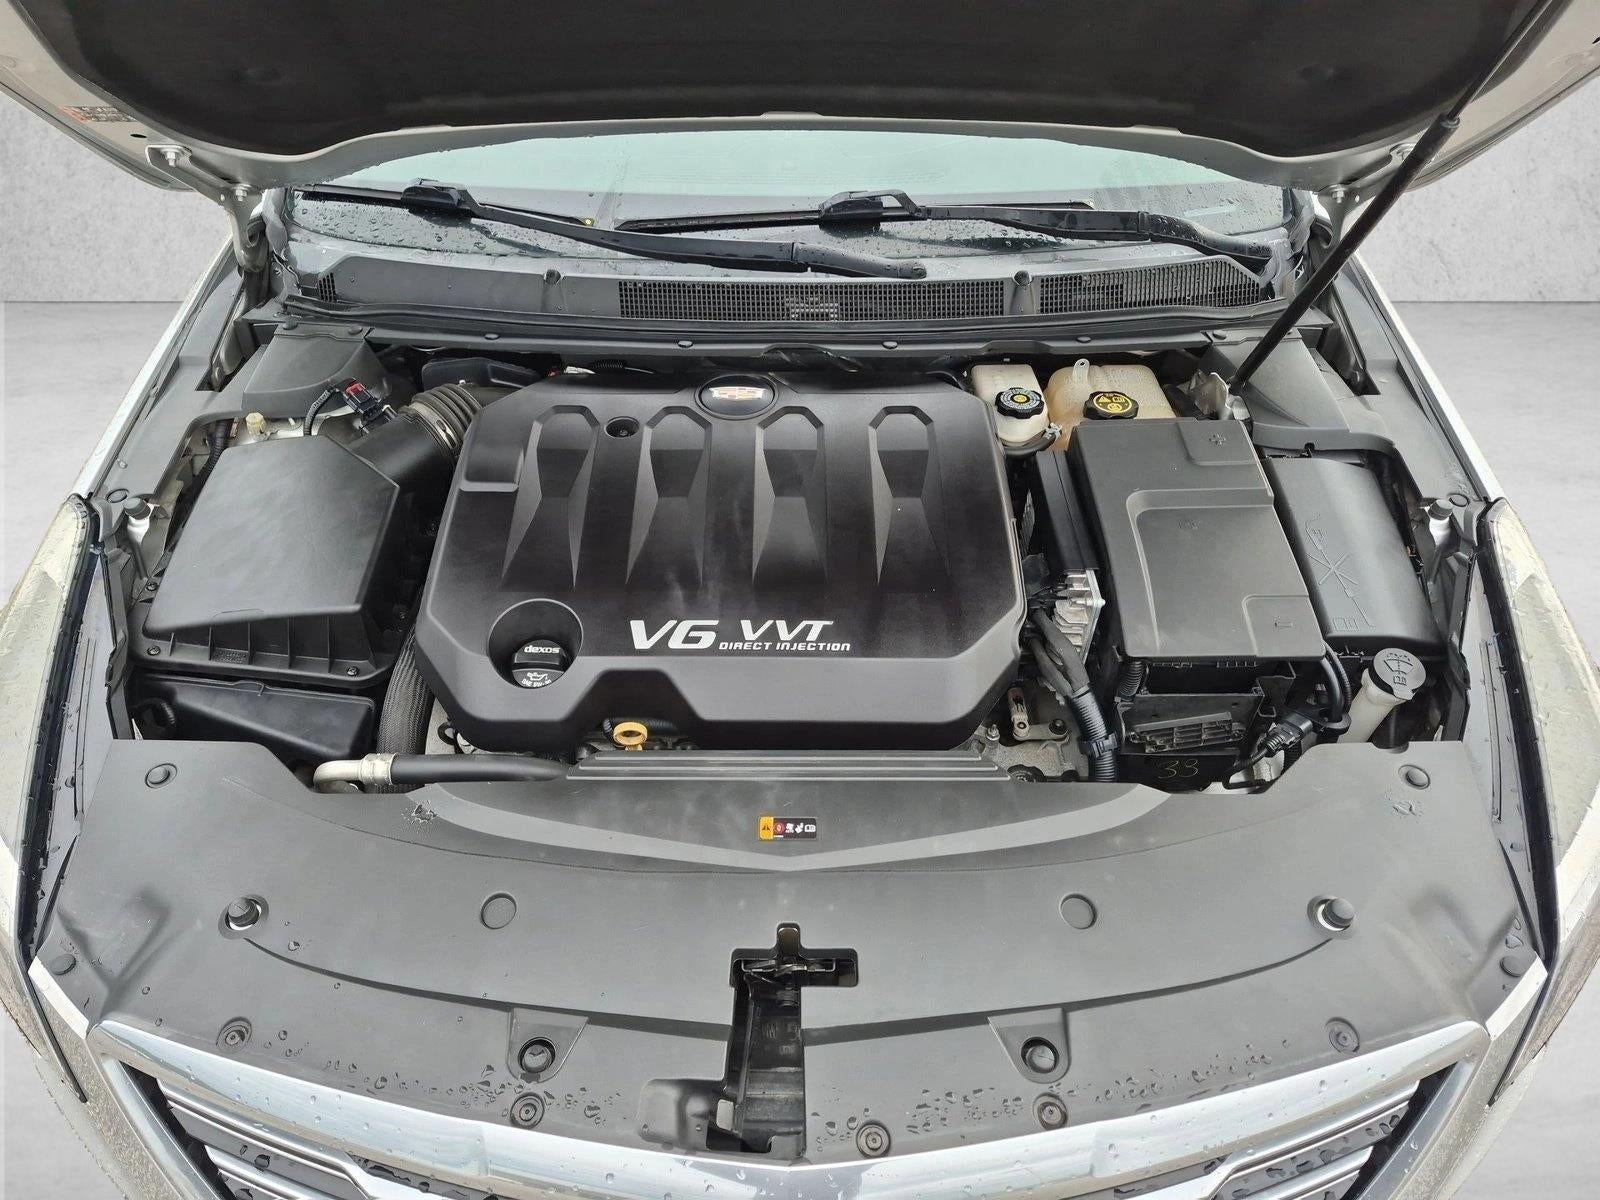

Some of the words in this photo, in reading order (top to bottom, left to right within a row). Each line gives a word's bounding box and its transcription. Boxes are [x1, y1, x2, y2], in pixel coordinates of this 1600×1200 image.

[630, 619, 719, 649] V6
[740, 619, 834, 641] VVT
[524, 645, 561, 654] dexos
[718, 642, 772, 651] DIRECT
